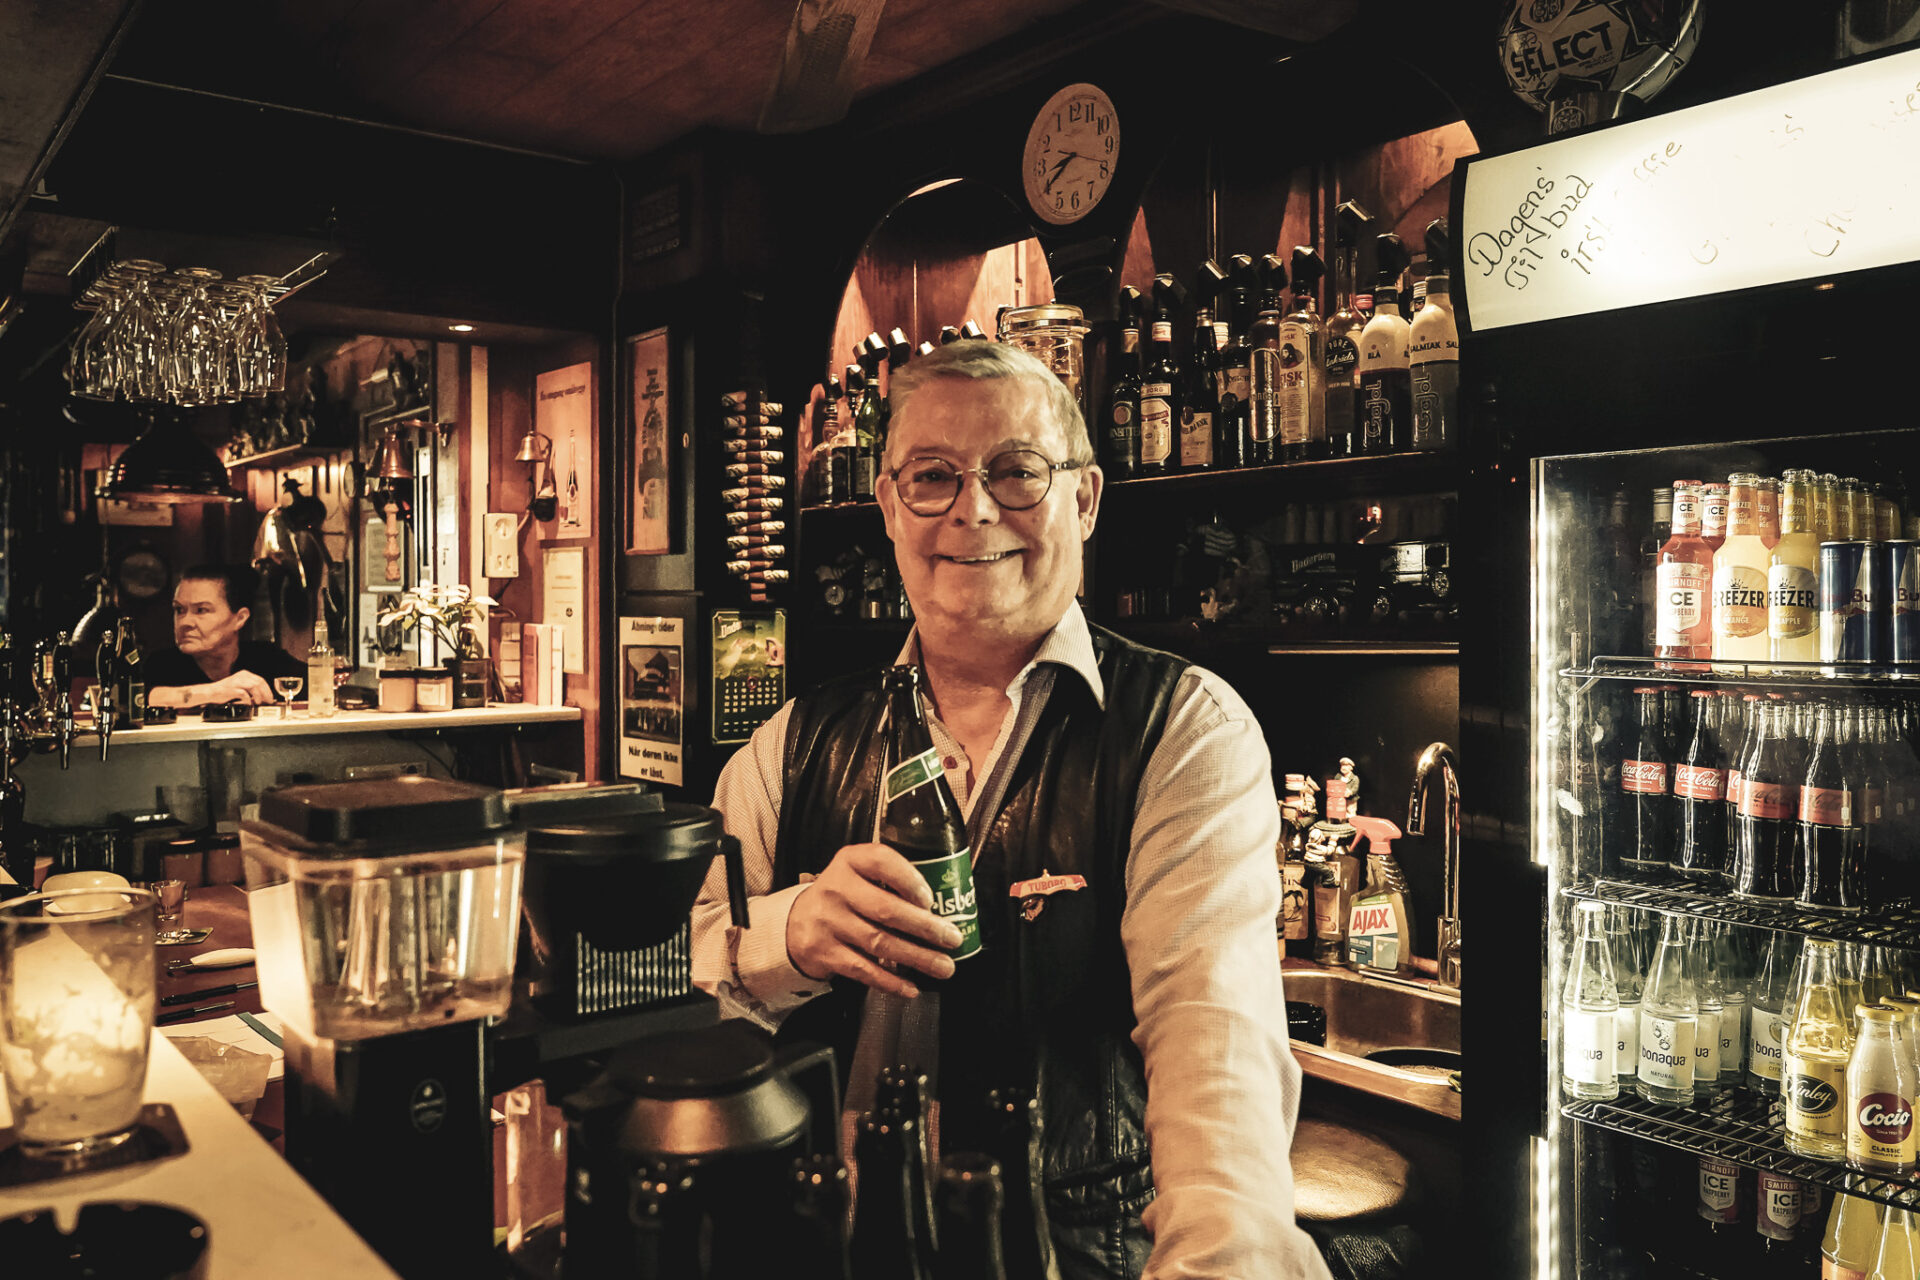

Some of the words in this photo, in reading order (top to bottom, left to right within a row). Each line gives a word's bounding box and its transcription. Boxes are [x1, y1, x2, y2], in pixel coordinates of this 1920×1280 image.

[1510, 20, 1613, 78] SELECT
[1069, 101, 1082, 123] 12
[1085, 102, 1095, 123] 11
[1056, 113, 1062, 133] 1
[1097, 114, 1110, 136] 10
[1041, 134, 1051, 154] 2
[1104, 135, 1114, 154] 9
[1033, 158, 1047, 177] 3
[1099, 159, 1109, 179] 8
[1055, 190, 1064, 210] 5
[1070, 190, 1080, 210] 6
[1086, 180, 1095, 200] 7
[1028, 878, 1067, 892] TUBORG
[1352, 908, 1389, 935] AJAX
[1641, 1044, 1686, 1067] bonaqua
[1755, 1040, 1781, 1059] bona
[1859, 1103, 1910, 1126] Cocio
[1871, 1145, 1901, 1154] CLASSIC
[1703, 1173, 1729, 1190] ICE
[1773, 1193, 1799, 1206] ICE
